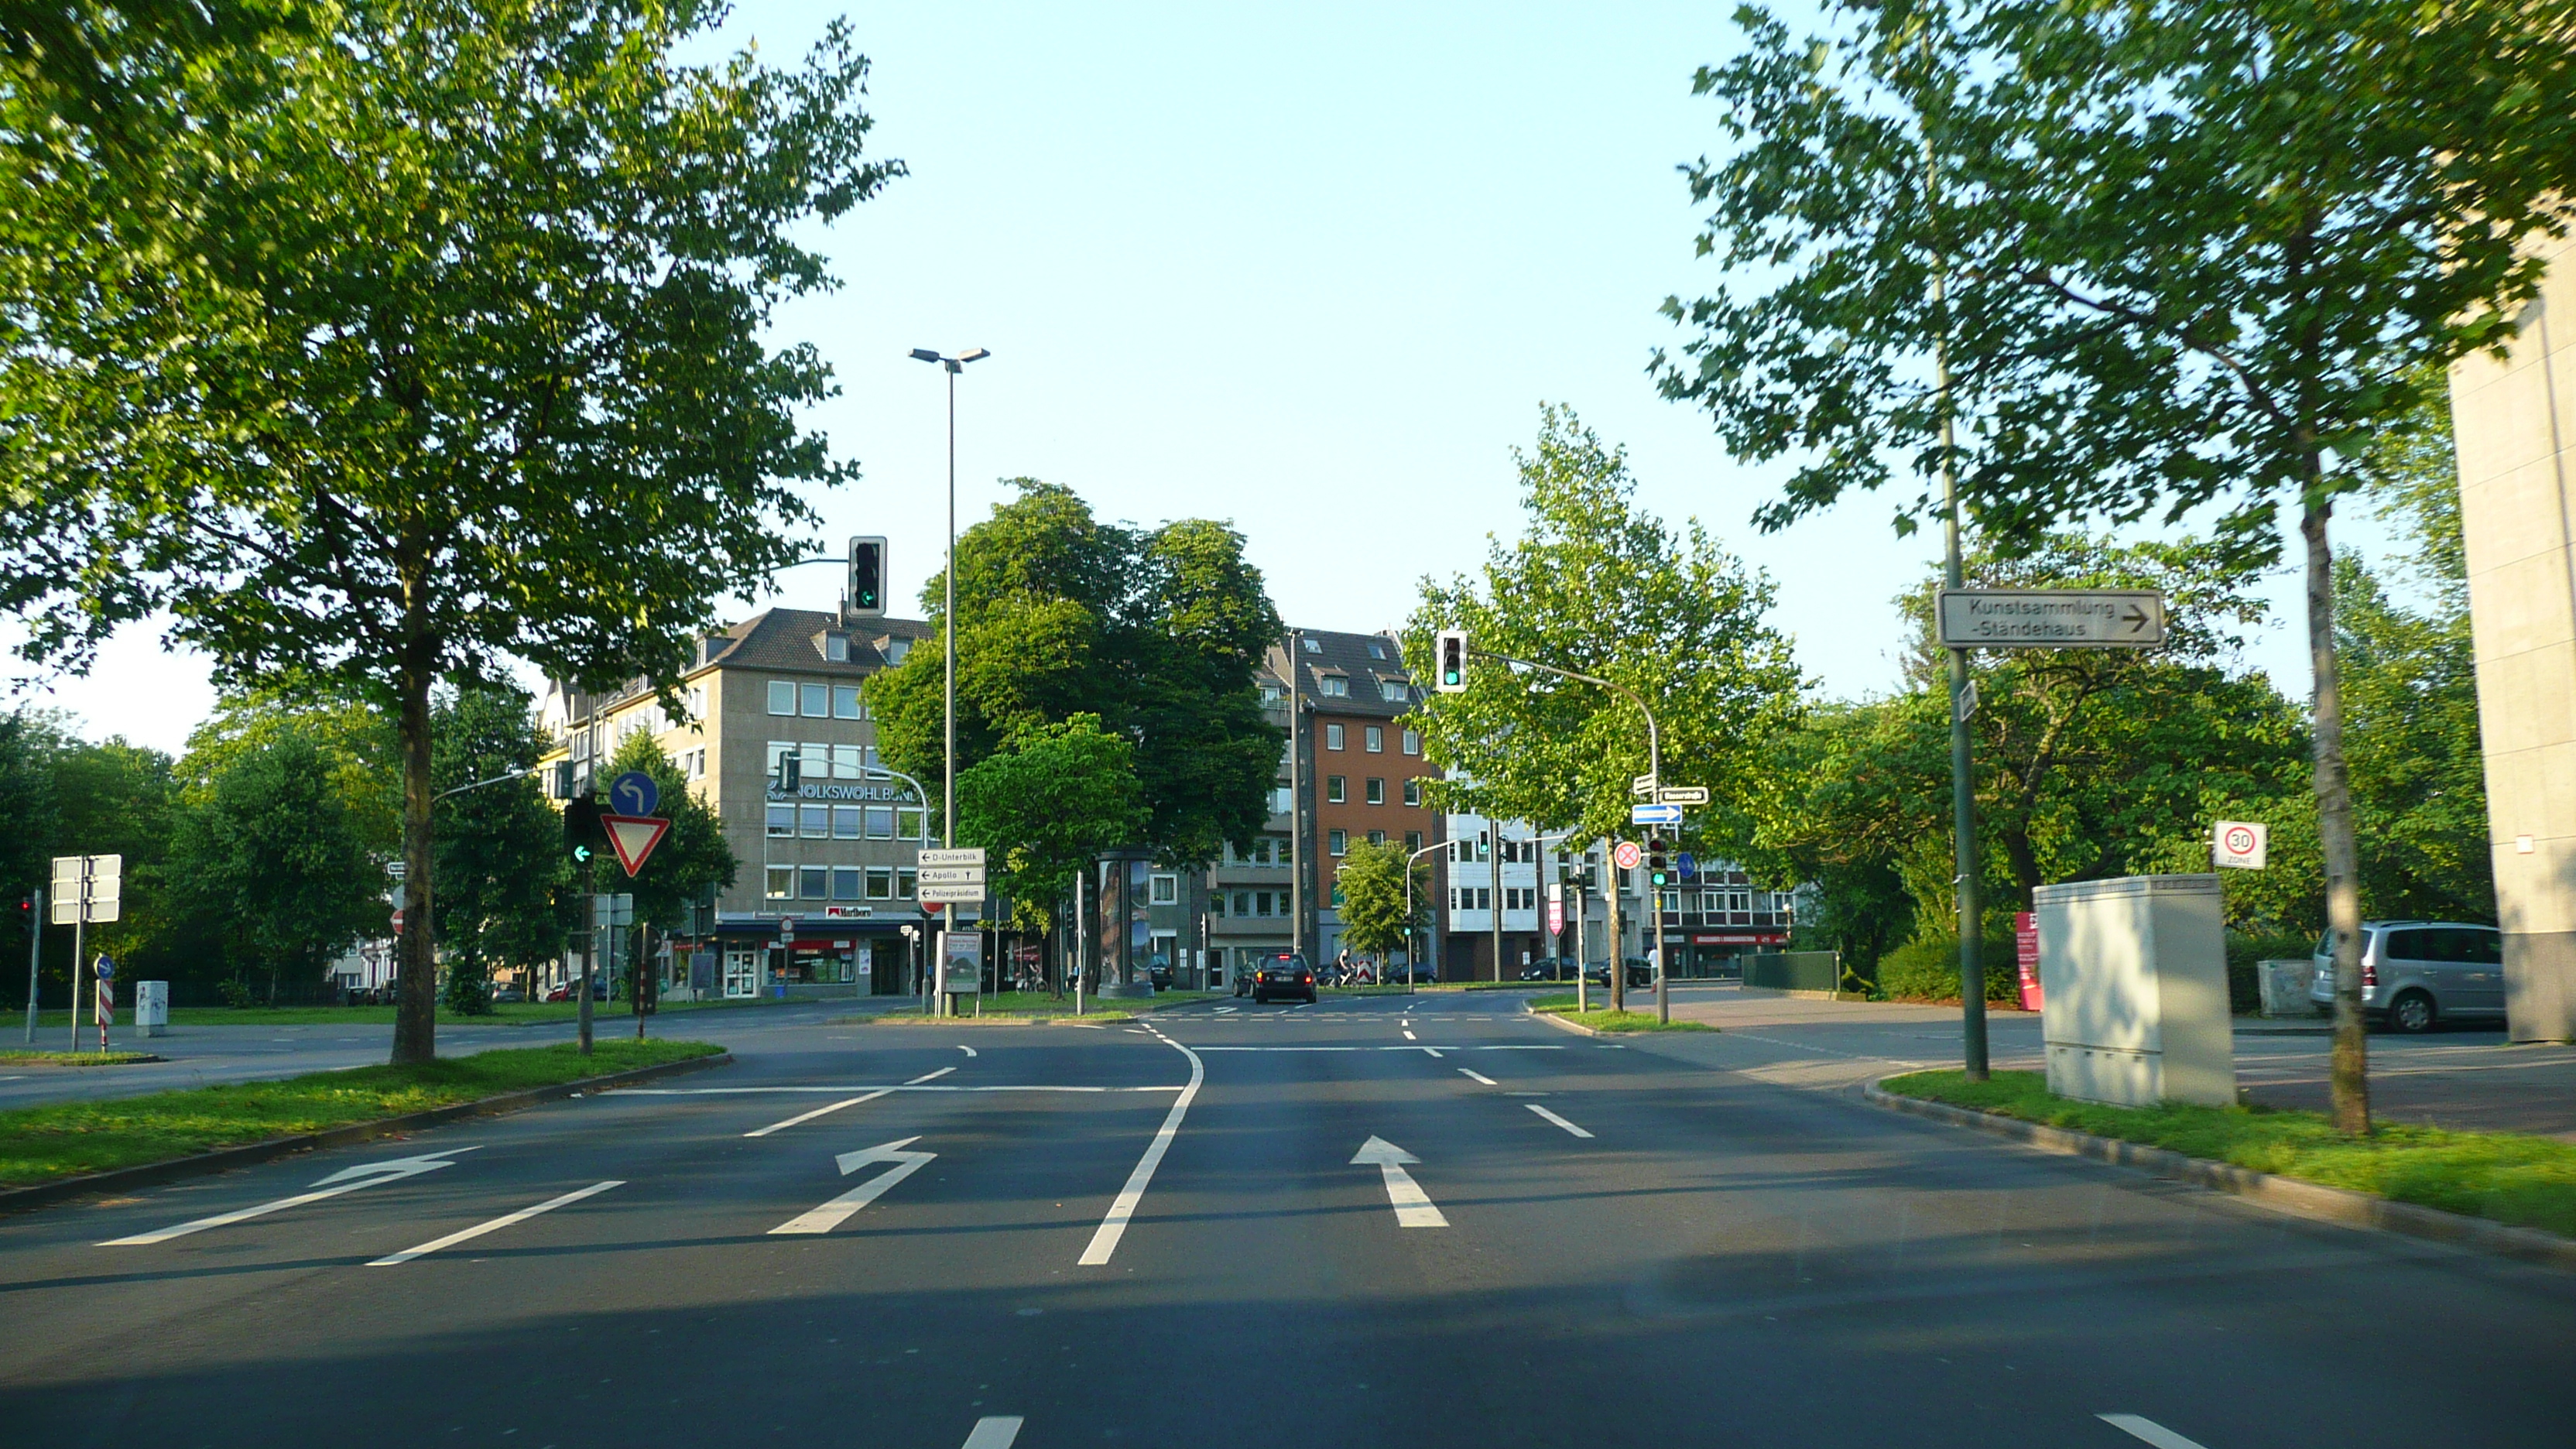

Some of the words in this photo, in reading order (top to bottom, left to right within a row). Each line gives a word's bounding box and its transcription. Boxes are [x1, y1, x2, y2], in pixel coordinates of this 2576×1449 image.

[1969, 599, 2115, 618] Kunstsammlung
[1971, 620, 2087, 637] -Ständehaus
[2232, 834, 2250, 848] 30
[2227, 856, 2252, 865] ZONE
[932, 871, 957, 880] Apollo
[932, 889, 979, 898] Polizeipräsidium
[839, 907, 872, 918] Marlboro
